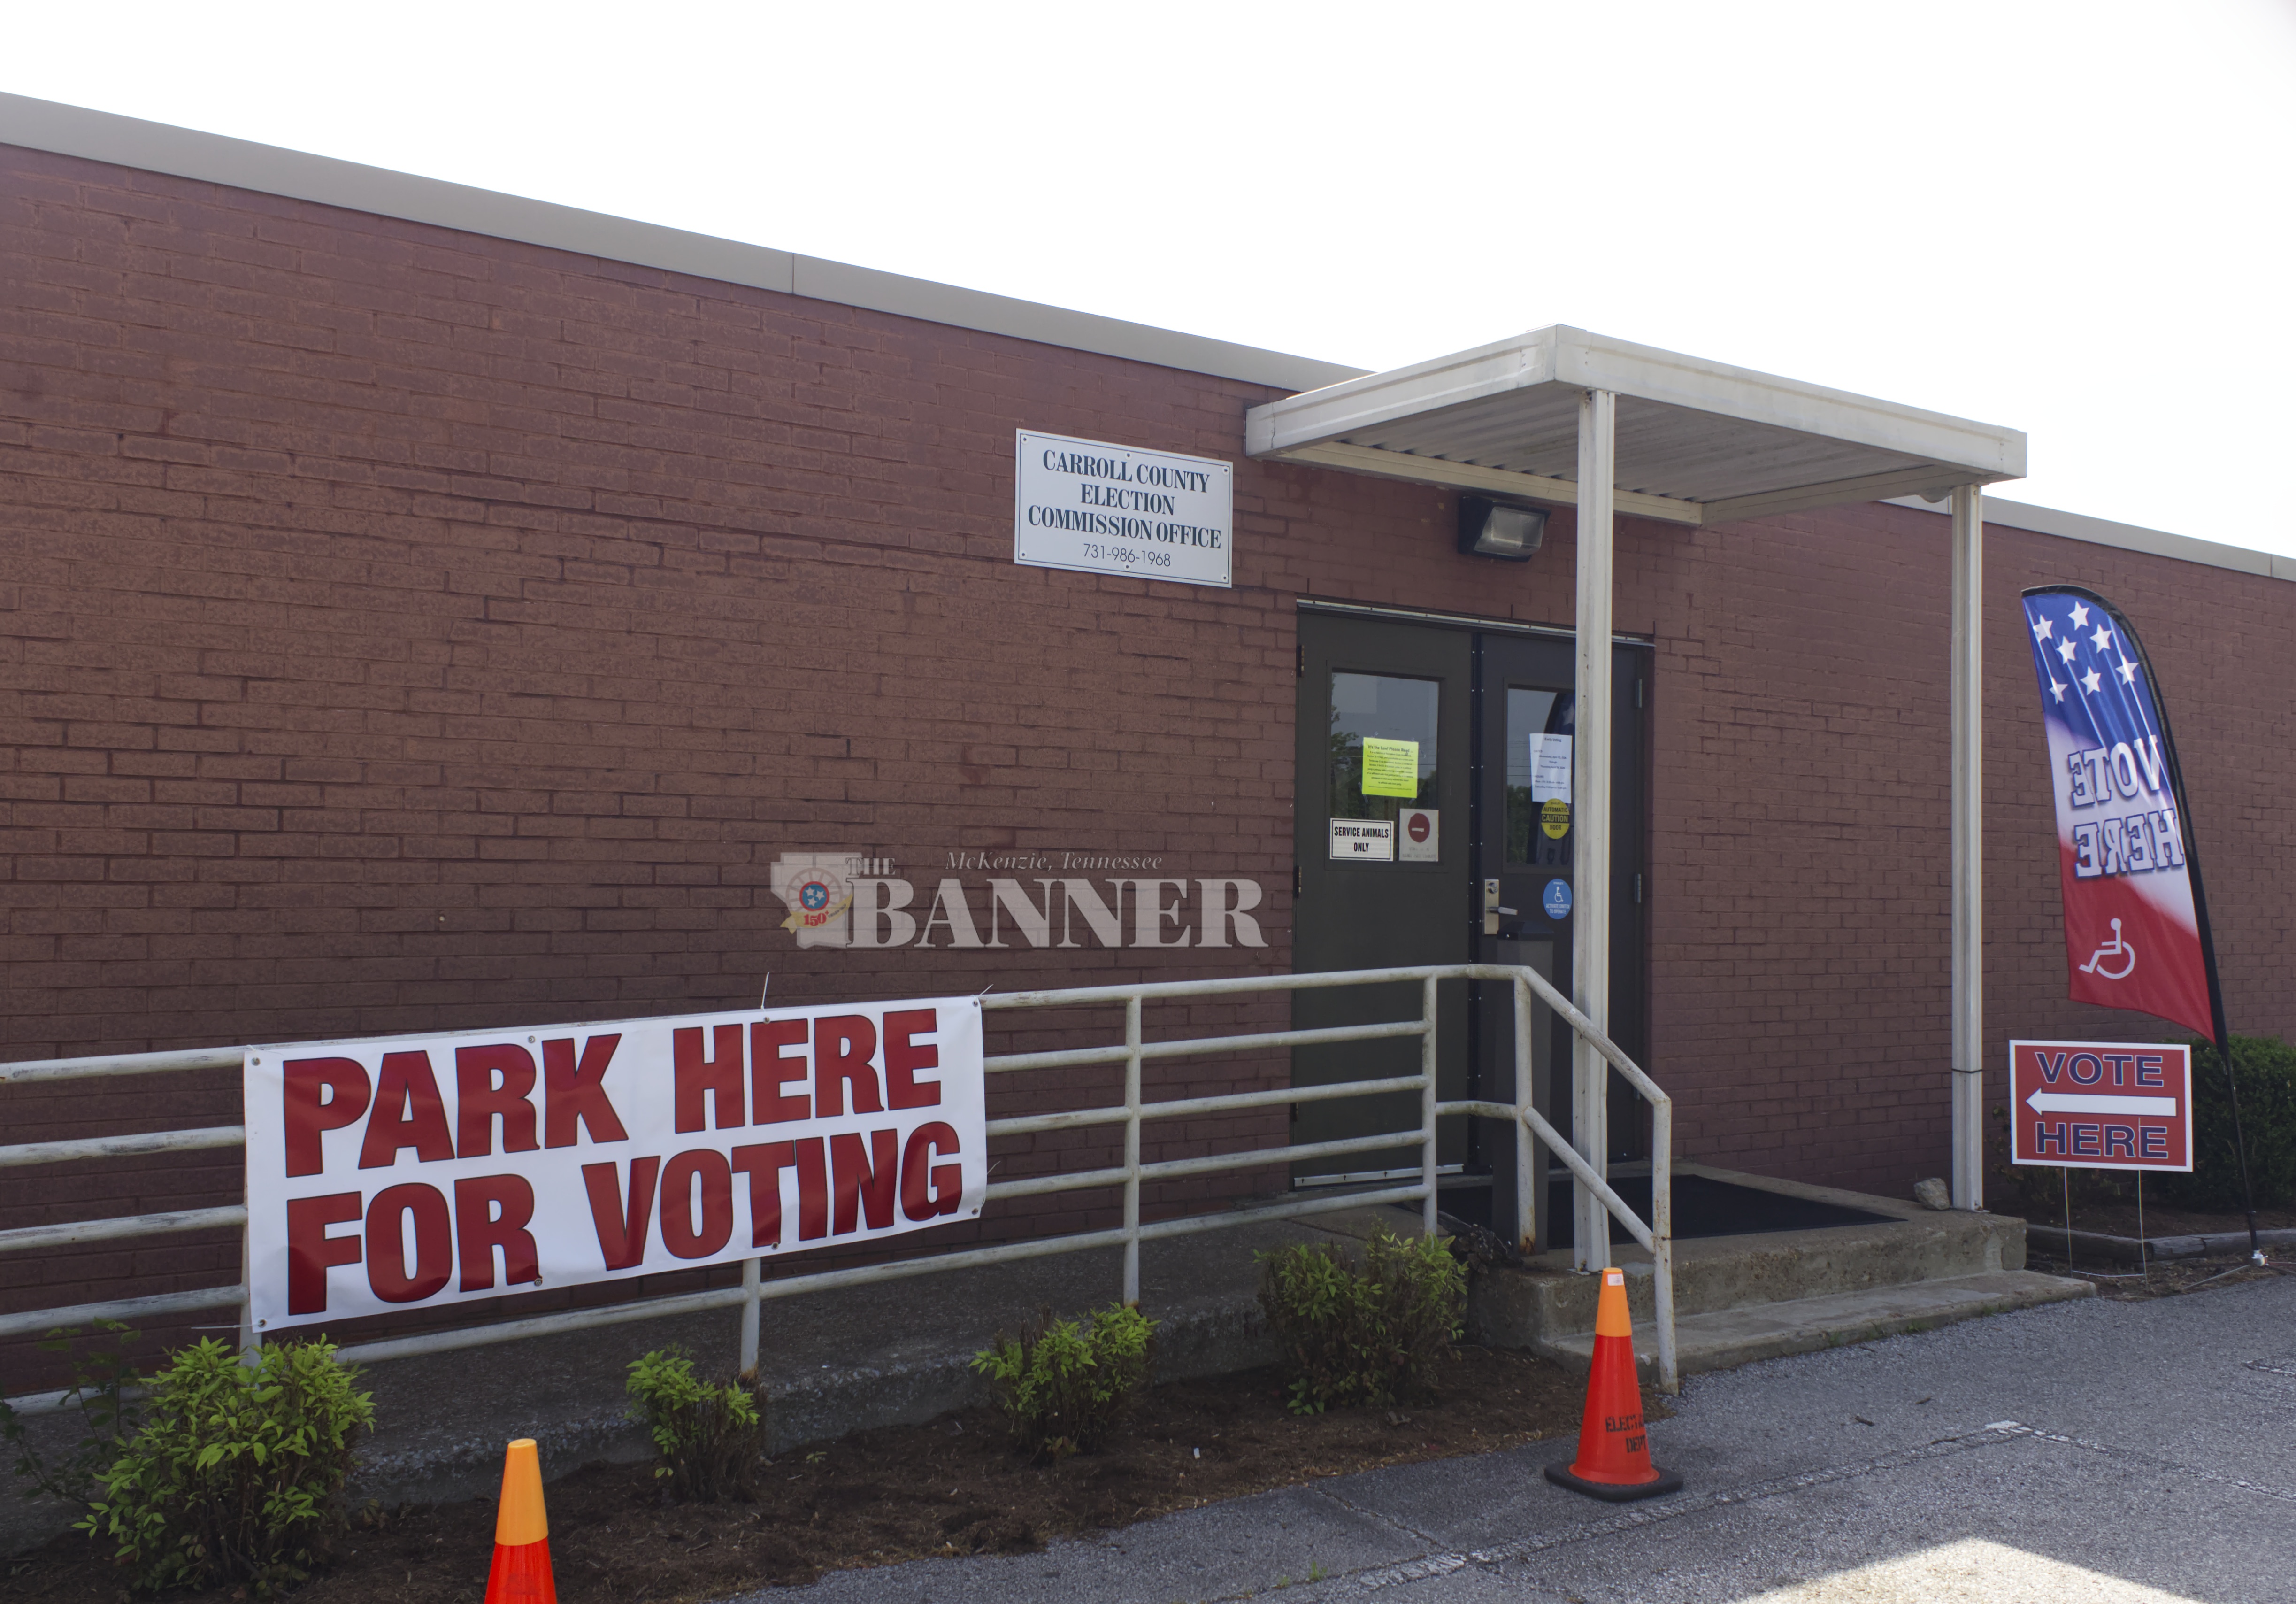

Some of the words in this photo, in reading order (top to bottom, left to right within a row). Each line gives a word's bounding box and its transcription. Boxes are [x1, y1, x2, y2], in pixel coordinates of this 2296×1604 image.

[1043, 449, 1132, 482] CARROLL
[1136, 464, 1210, 493] COUNTY
[1080, 483, 1175, 516] ELECTION
[1028, 505, 1153, 540] COMMISSION
[1156, 522, 1221, 549] OFFICE
[1083, 543, 1171, 567] 731-986-1968
[1334, 826, 1360, 837] SERVICE
[1362, 828, 1389, 838] ANIMALS
[1542, 814, 1568, 823] CAUTION
[1353, 842, 1369, 852] ONLY
[2034, 1052, 2164, 1087] VOTE
[283, 1032, 629, 1179] PARK
[672, 1008, 942, 1135] HERE
[2035, 1121, 2168, 1159] HERE
[286, 1172, 542, 1316] FOR
[580, 1120, 962, 1271] VOTING
